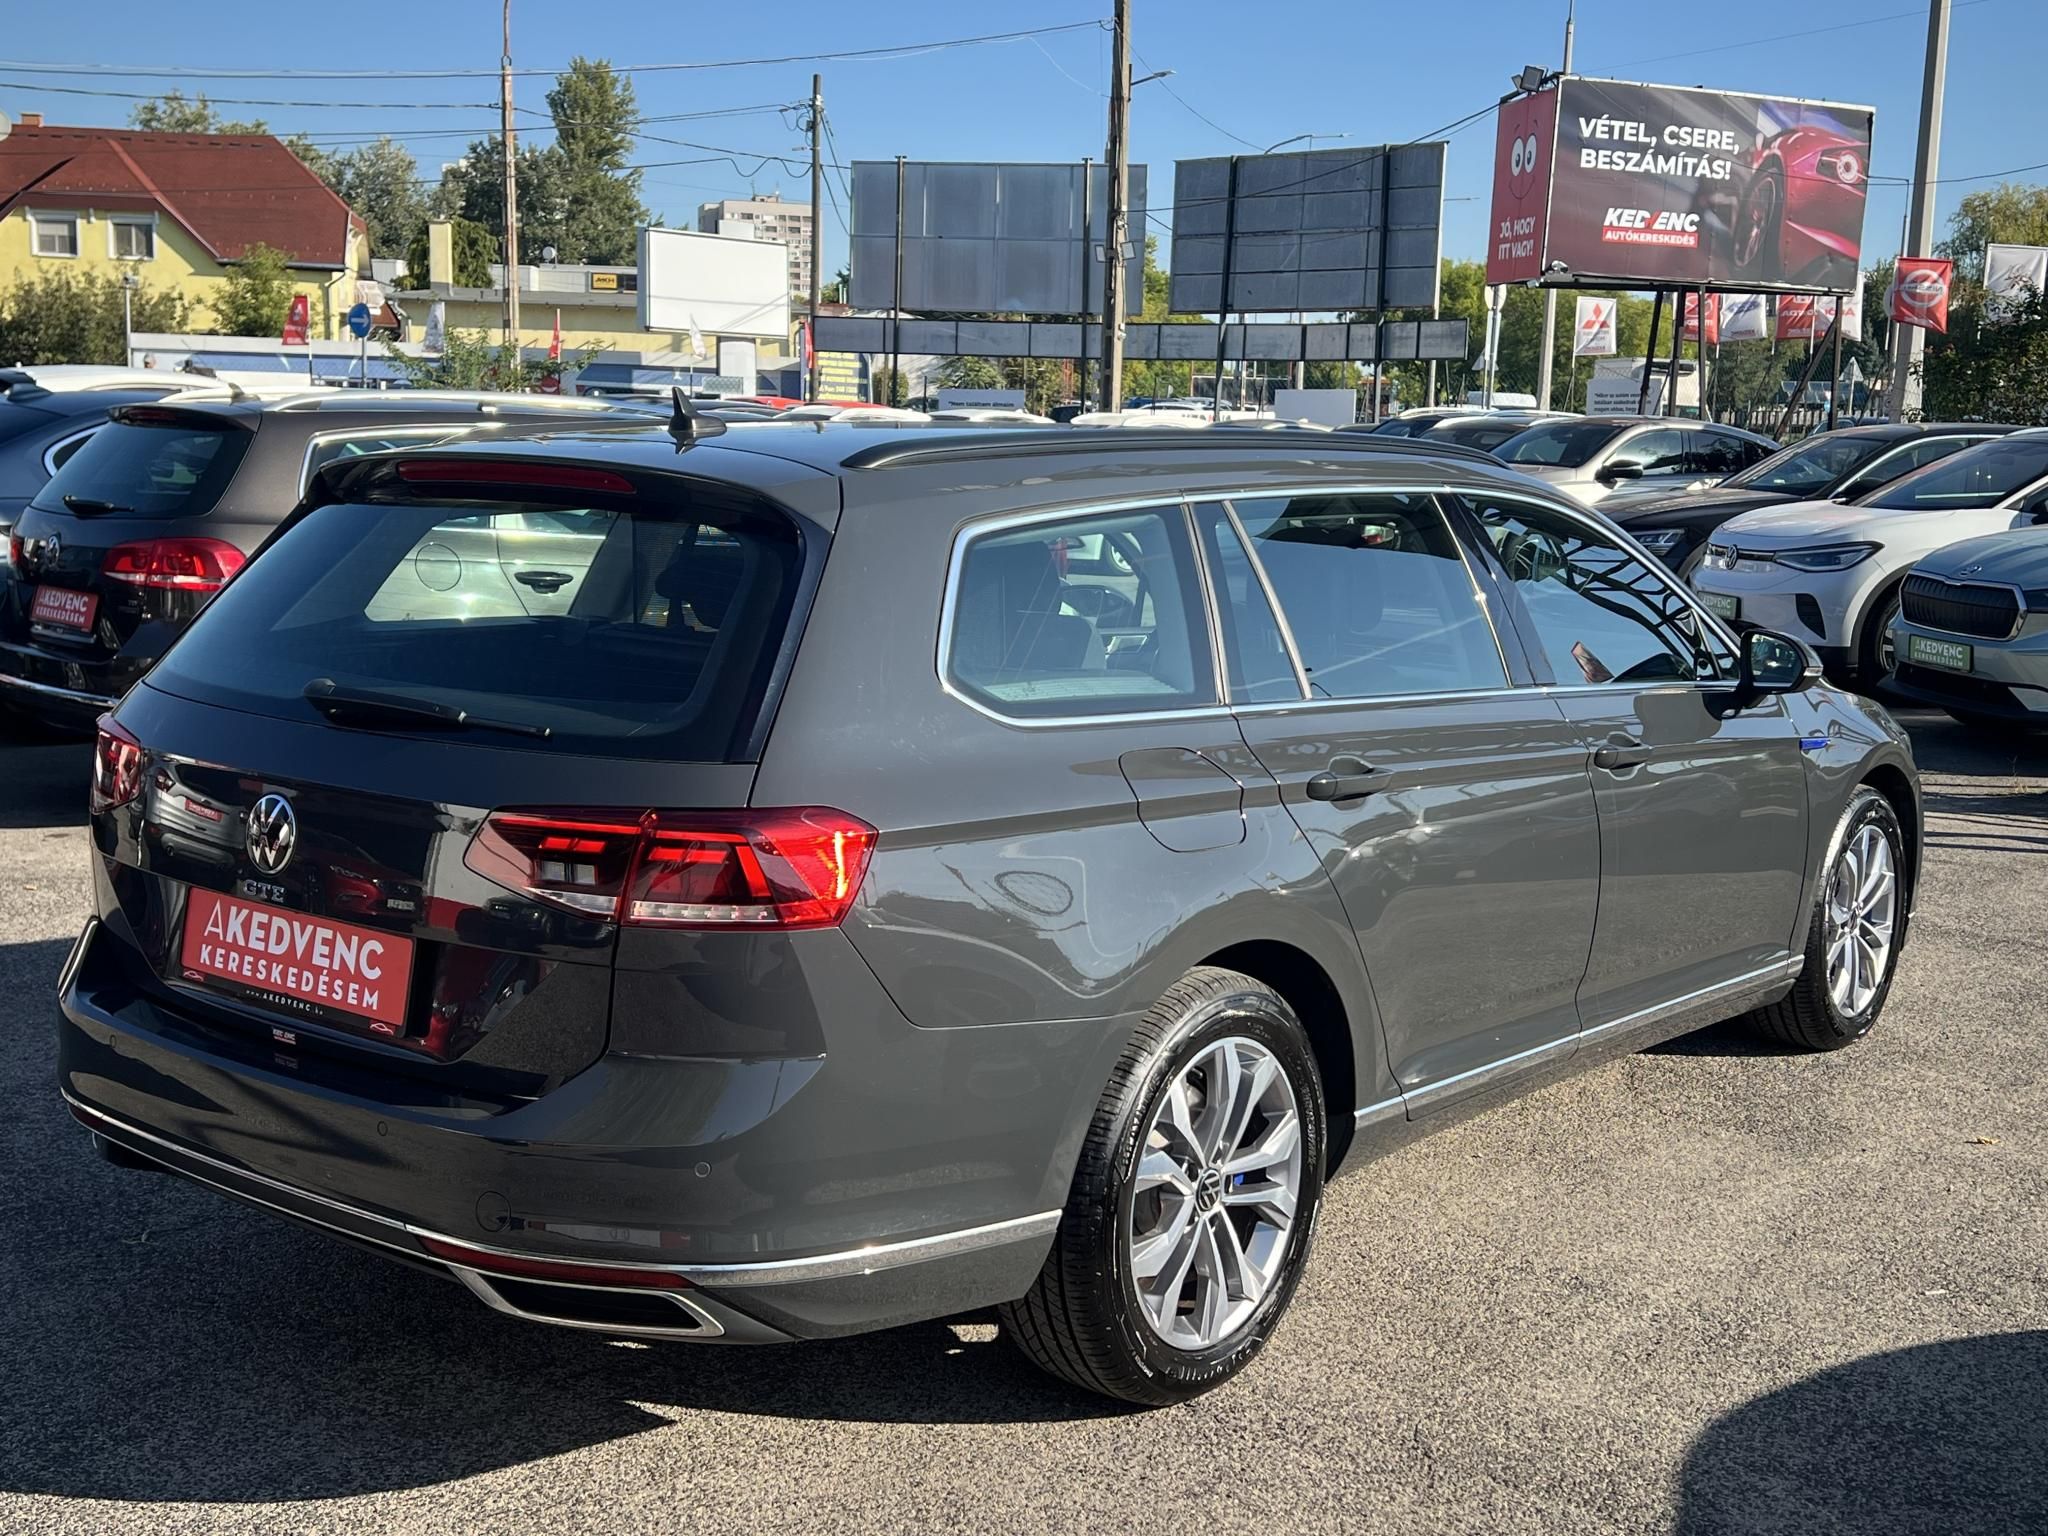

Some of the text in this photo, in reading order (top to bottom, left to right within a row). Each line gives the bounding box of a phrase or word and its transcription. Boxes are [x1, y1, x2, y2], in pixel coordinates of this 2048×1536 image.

[1578, 114, 1740, 155] VÉTEL, CSERE,
[1580, 148, 1732, 180] BESZÁMÍTÁS!
[1500, 216, 1536, 238] JÓ, HOGY
[1605, 229, 1696, 246] AUTÓKERESKEDÉS
[1498, 239, 1534, 260] ITT VAGY!
[1915, 639, 1963, 659] AKEDVENC
[243, 879, 287, 904] GTE
[203, 899, 384, 980] AKEDVENC
[199, 943, 379, 1011] KERESKEDÉSEM
